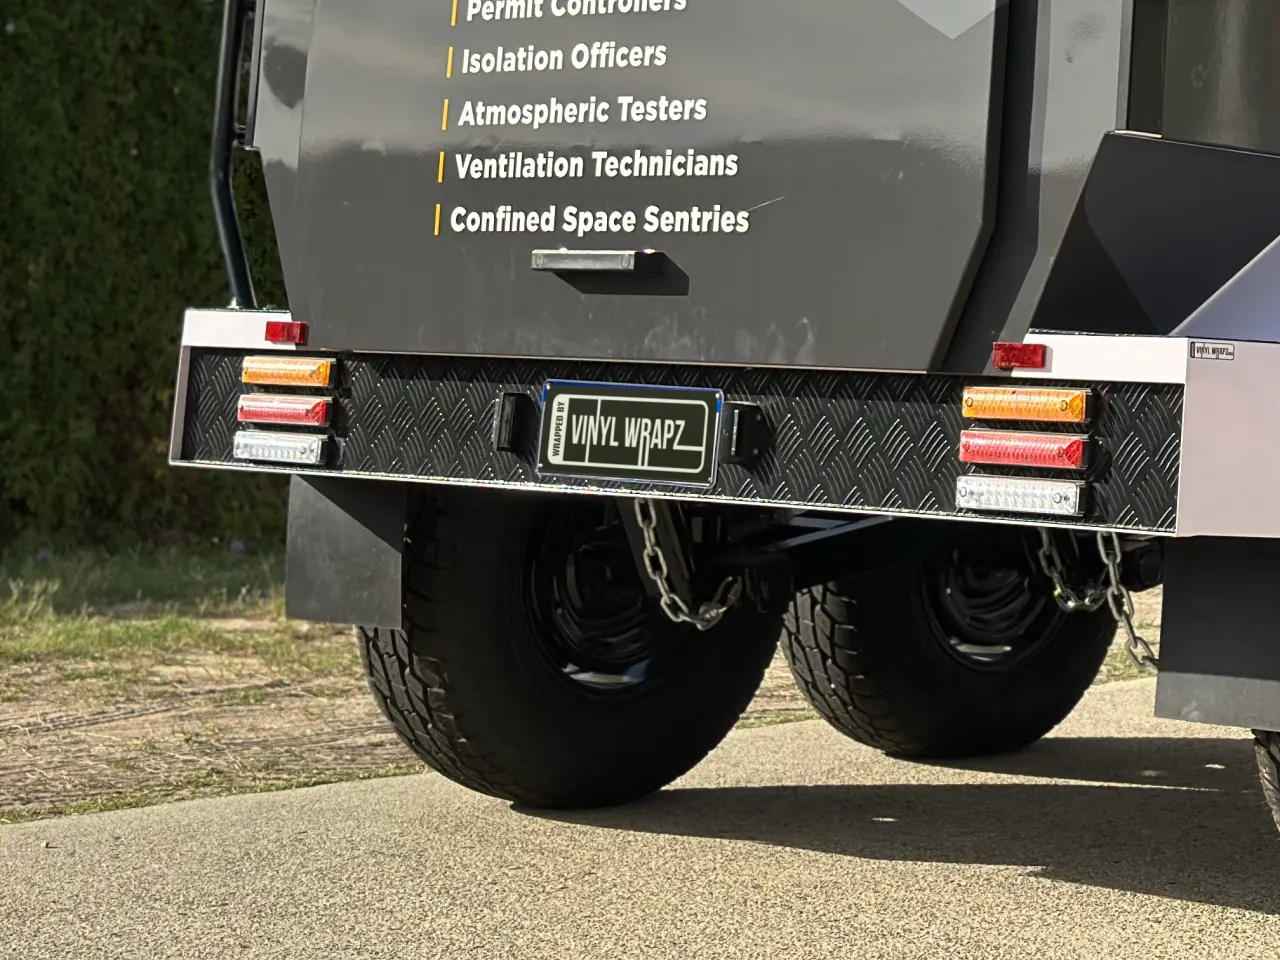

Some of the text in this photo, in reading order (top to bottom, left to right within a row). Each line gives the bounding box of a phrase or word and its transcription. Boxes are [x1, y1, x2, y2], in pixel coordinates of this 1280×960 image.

[462, 42, 667, 74] Isolation Officers
[457, 95, 707, 129] Atmospheric Testers
[455, 149, 739, 180] Ventilation Technicians
[450, 205, 750, 238] Confined Space Sentries
[552, 401, 565, 457] WRAPPED BY
[571, 413, 687, 451] VINYL WRAPZ
